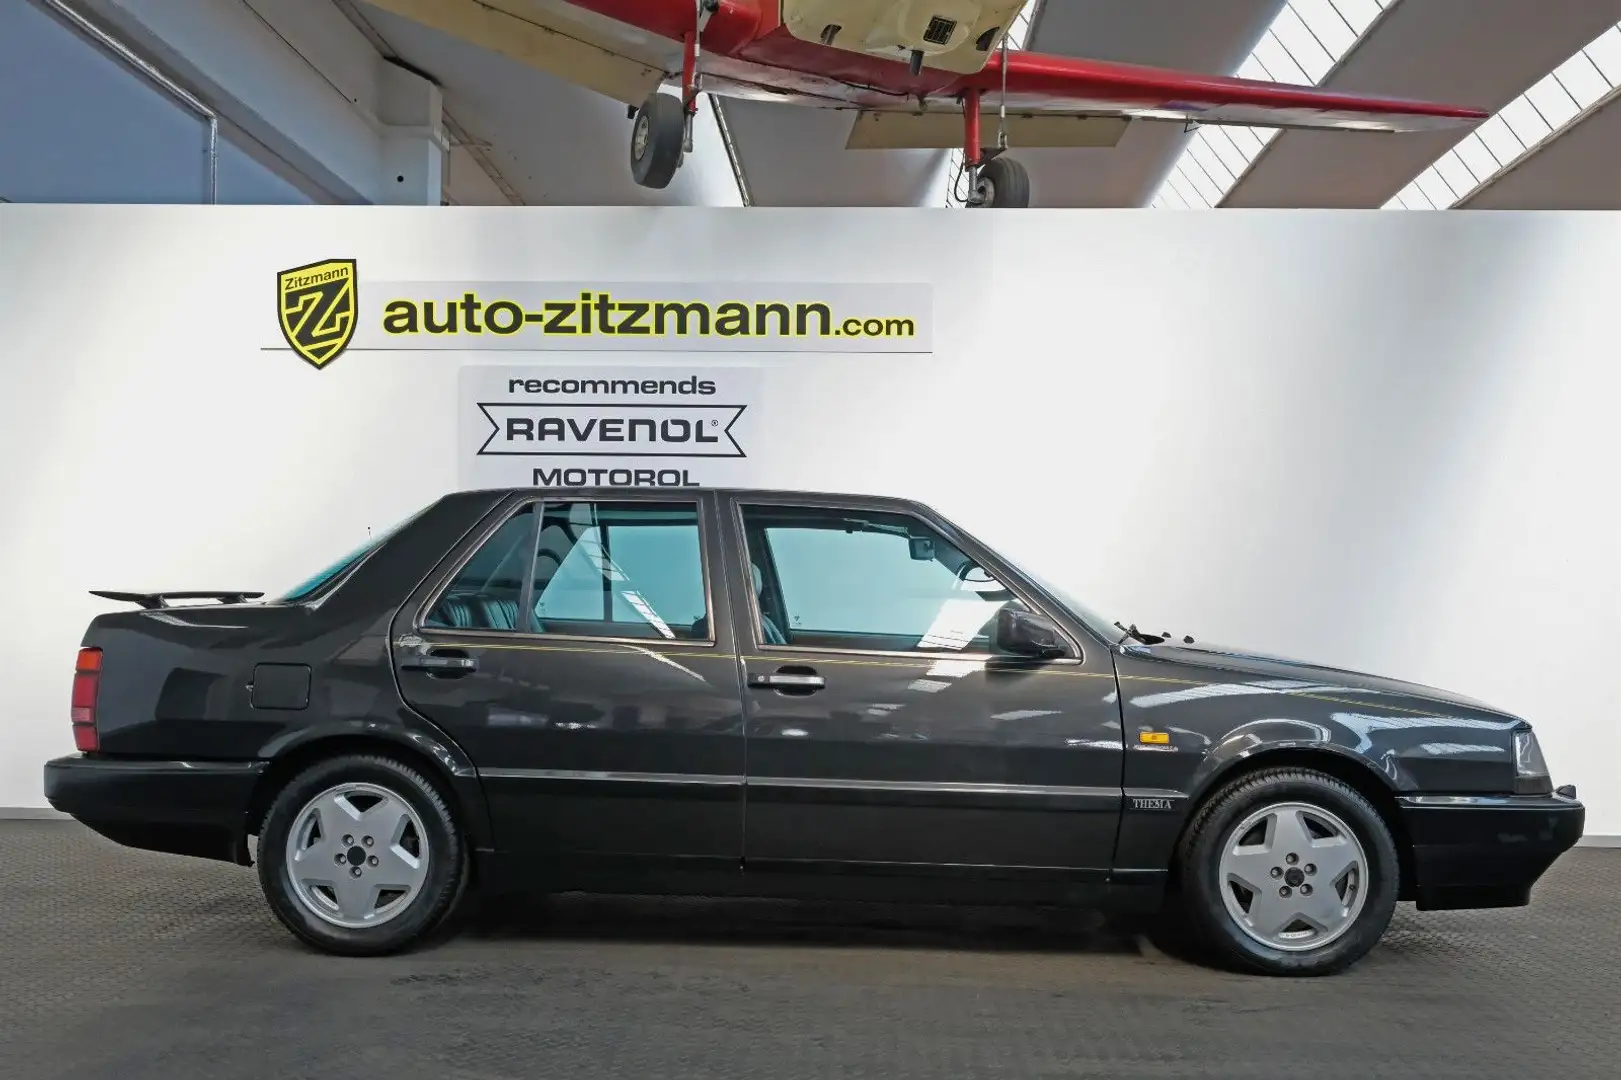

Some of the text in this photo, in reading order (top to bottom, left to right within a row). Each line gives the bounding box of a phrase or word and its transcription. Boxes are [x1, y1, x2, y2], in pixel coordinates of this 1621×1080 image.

[285, 267, 349, 290] Zitzmann
[383, 291, 915, 337] auto-zitzmann.com
[508, 376, 717, 395] recommends
[533, 468, 700, 487] MOTOROL
[1132, 799, 1172, 809] THEMA
